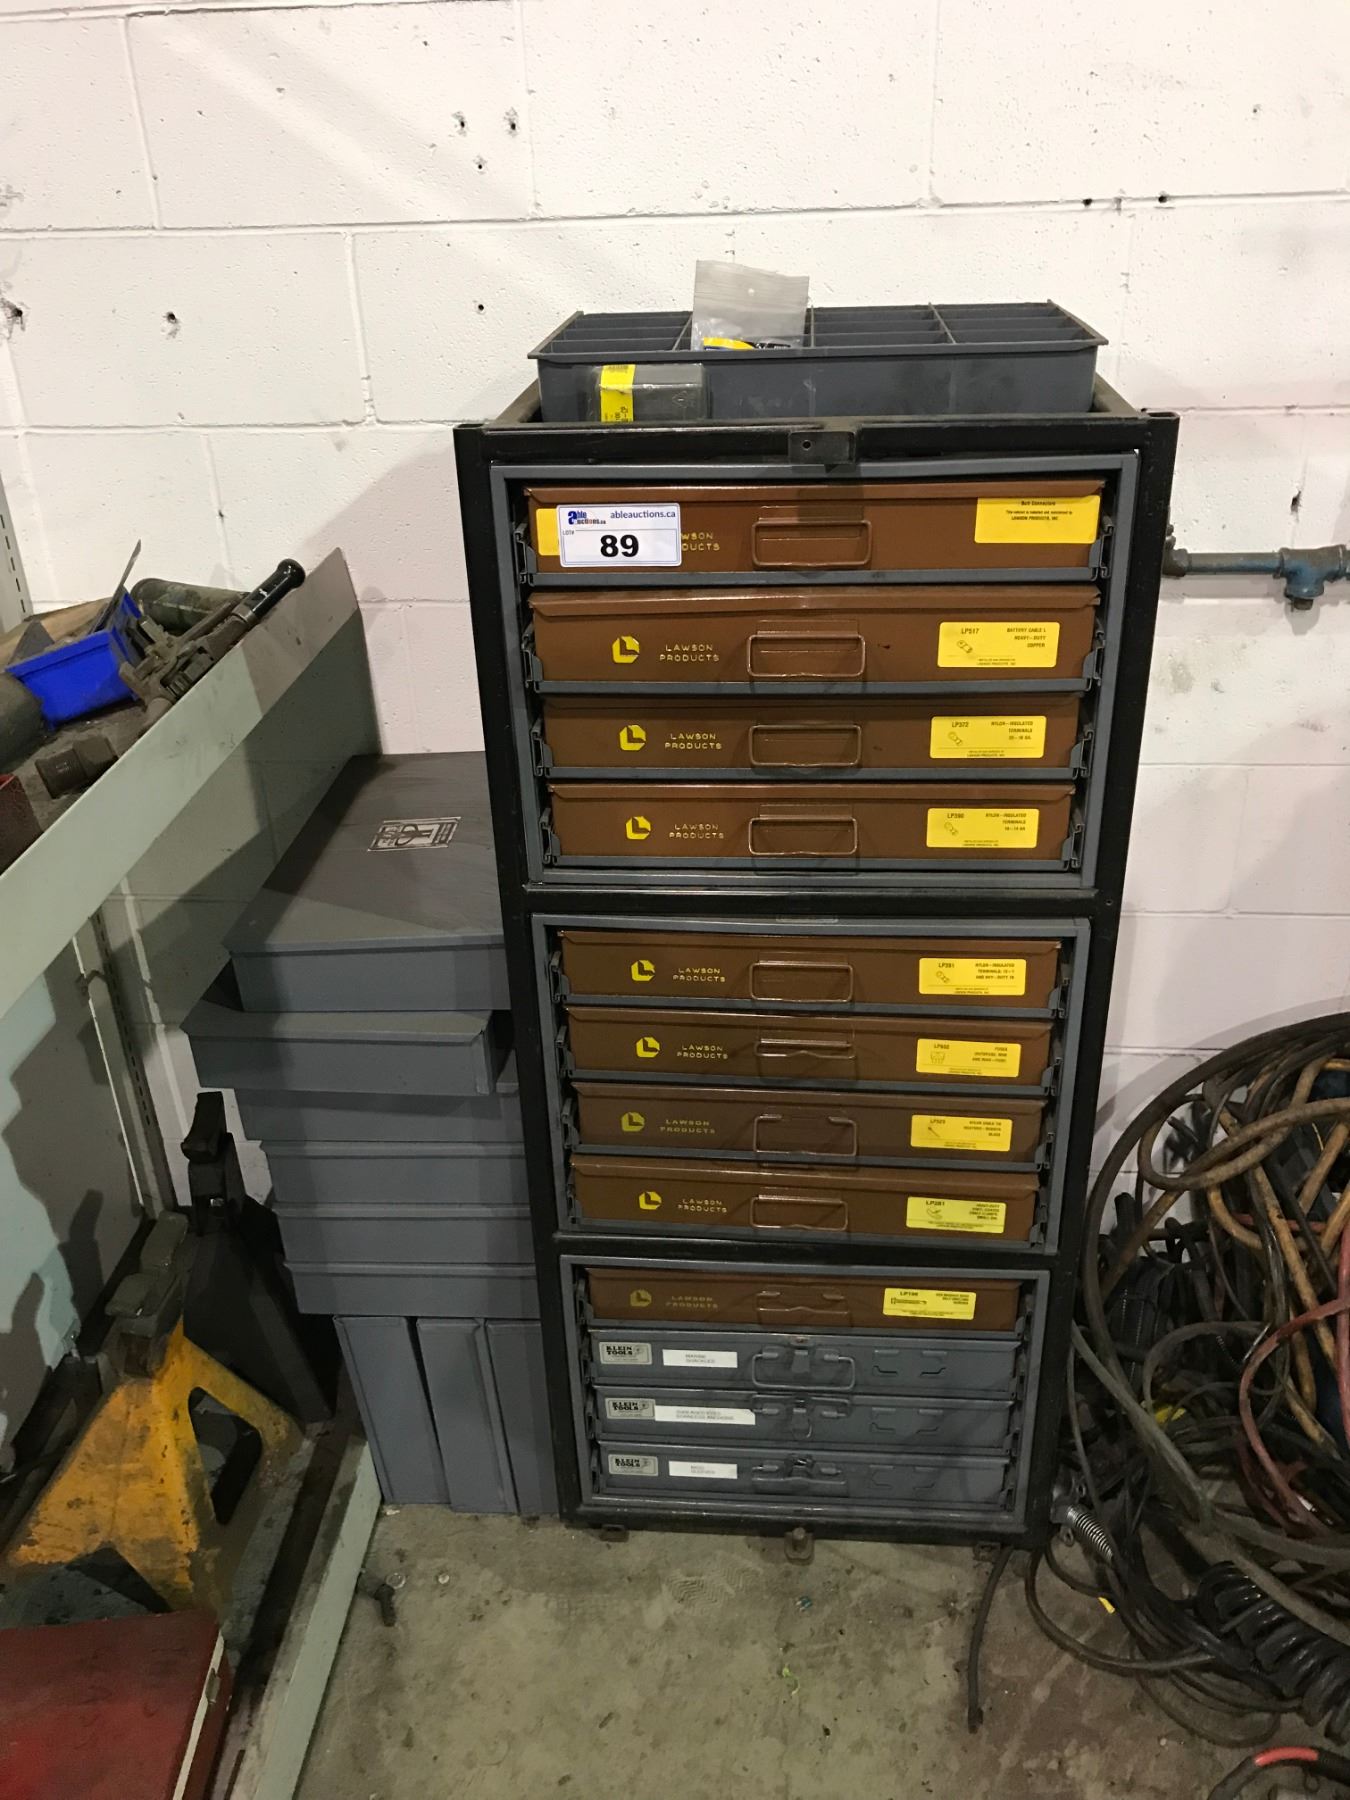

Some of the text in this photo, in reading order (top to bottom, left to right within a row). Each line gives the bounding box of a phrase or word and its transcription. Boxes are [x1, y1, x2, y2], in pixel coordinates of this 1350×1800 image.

[610, 510, 676, 519] ableauctions.ca
[681, 532, 714, 541] WSON
[600, 534, 639, 558] 89
[681, 542, 720, 552] DUCTS
[665, 644, 713, 652] LAWSON
[659, 654, 720, 662] PRODUCTS
[664, 742, 723, 750] PRODUCTS
[672, 974, 726, 983] PRODUCTS
[676, 1051, 728, 1059] PRODUCTS
[659, 1126, 716, 1134] PRODUCTS
[677, 1205, 728, 1213] PRODUCTS
